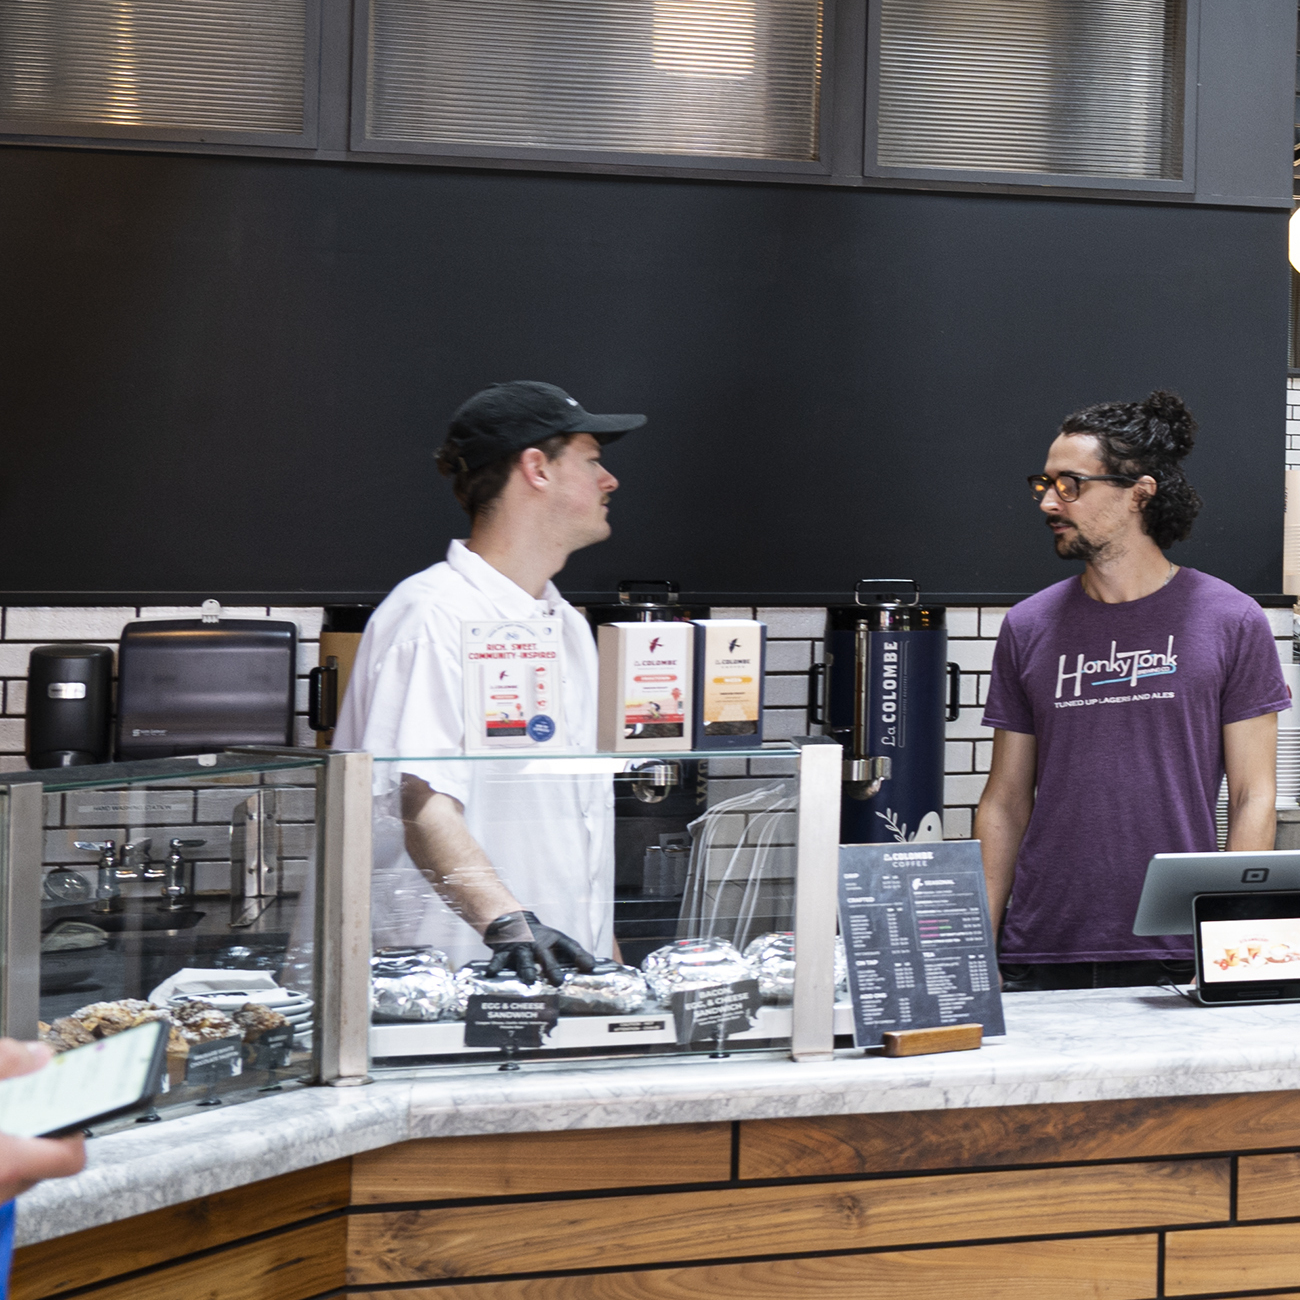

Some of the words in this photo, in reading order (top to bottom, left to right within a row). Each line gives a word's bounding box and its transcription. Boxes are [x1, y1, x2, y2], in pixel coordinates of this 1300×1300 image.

[882, 640, 898, 724] COLOMBE
[1054, 699, 1084, 708] TUNED
[1085, 698, 1098, 706] UP
[1098, 695, 1131, 704] LAGERS
[1132, 693, 1150, 701] AND
[1151, 691, 1175, 699] ALES
[881, 726, 896, 747] La
[892, 851, 934, 861] COLOMBE
[892, 860, 928, 868] COFFEE
[714, 992, 750, 1005] CHEESE
[481, 1002, 501, 1010] EGG
[502, 1002, 509, 1010] &
[510, 1002, 546, 1010] CHEESE
[693, 1002, 744, 1018] SANDWICH
[487, 1011, 539, 1019] SANDWICH
